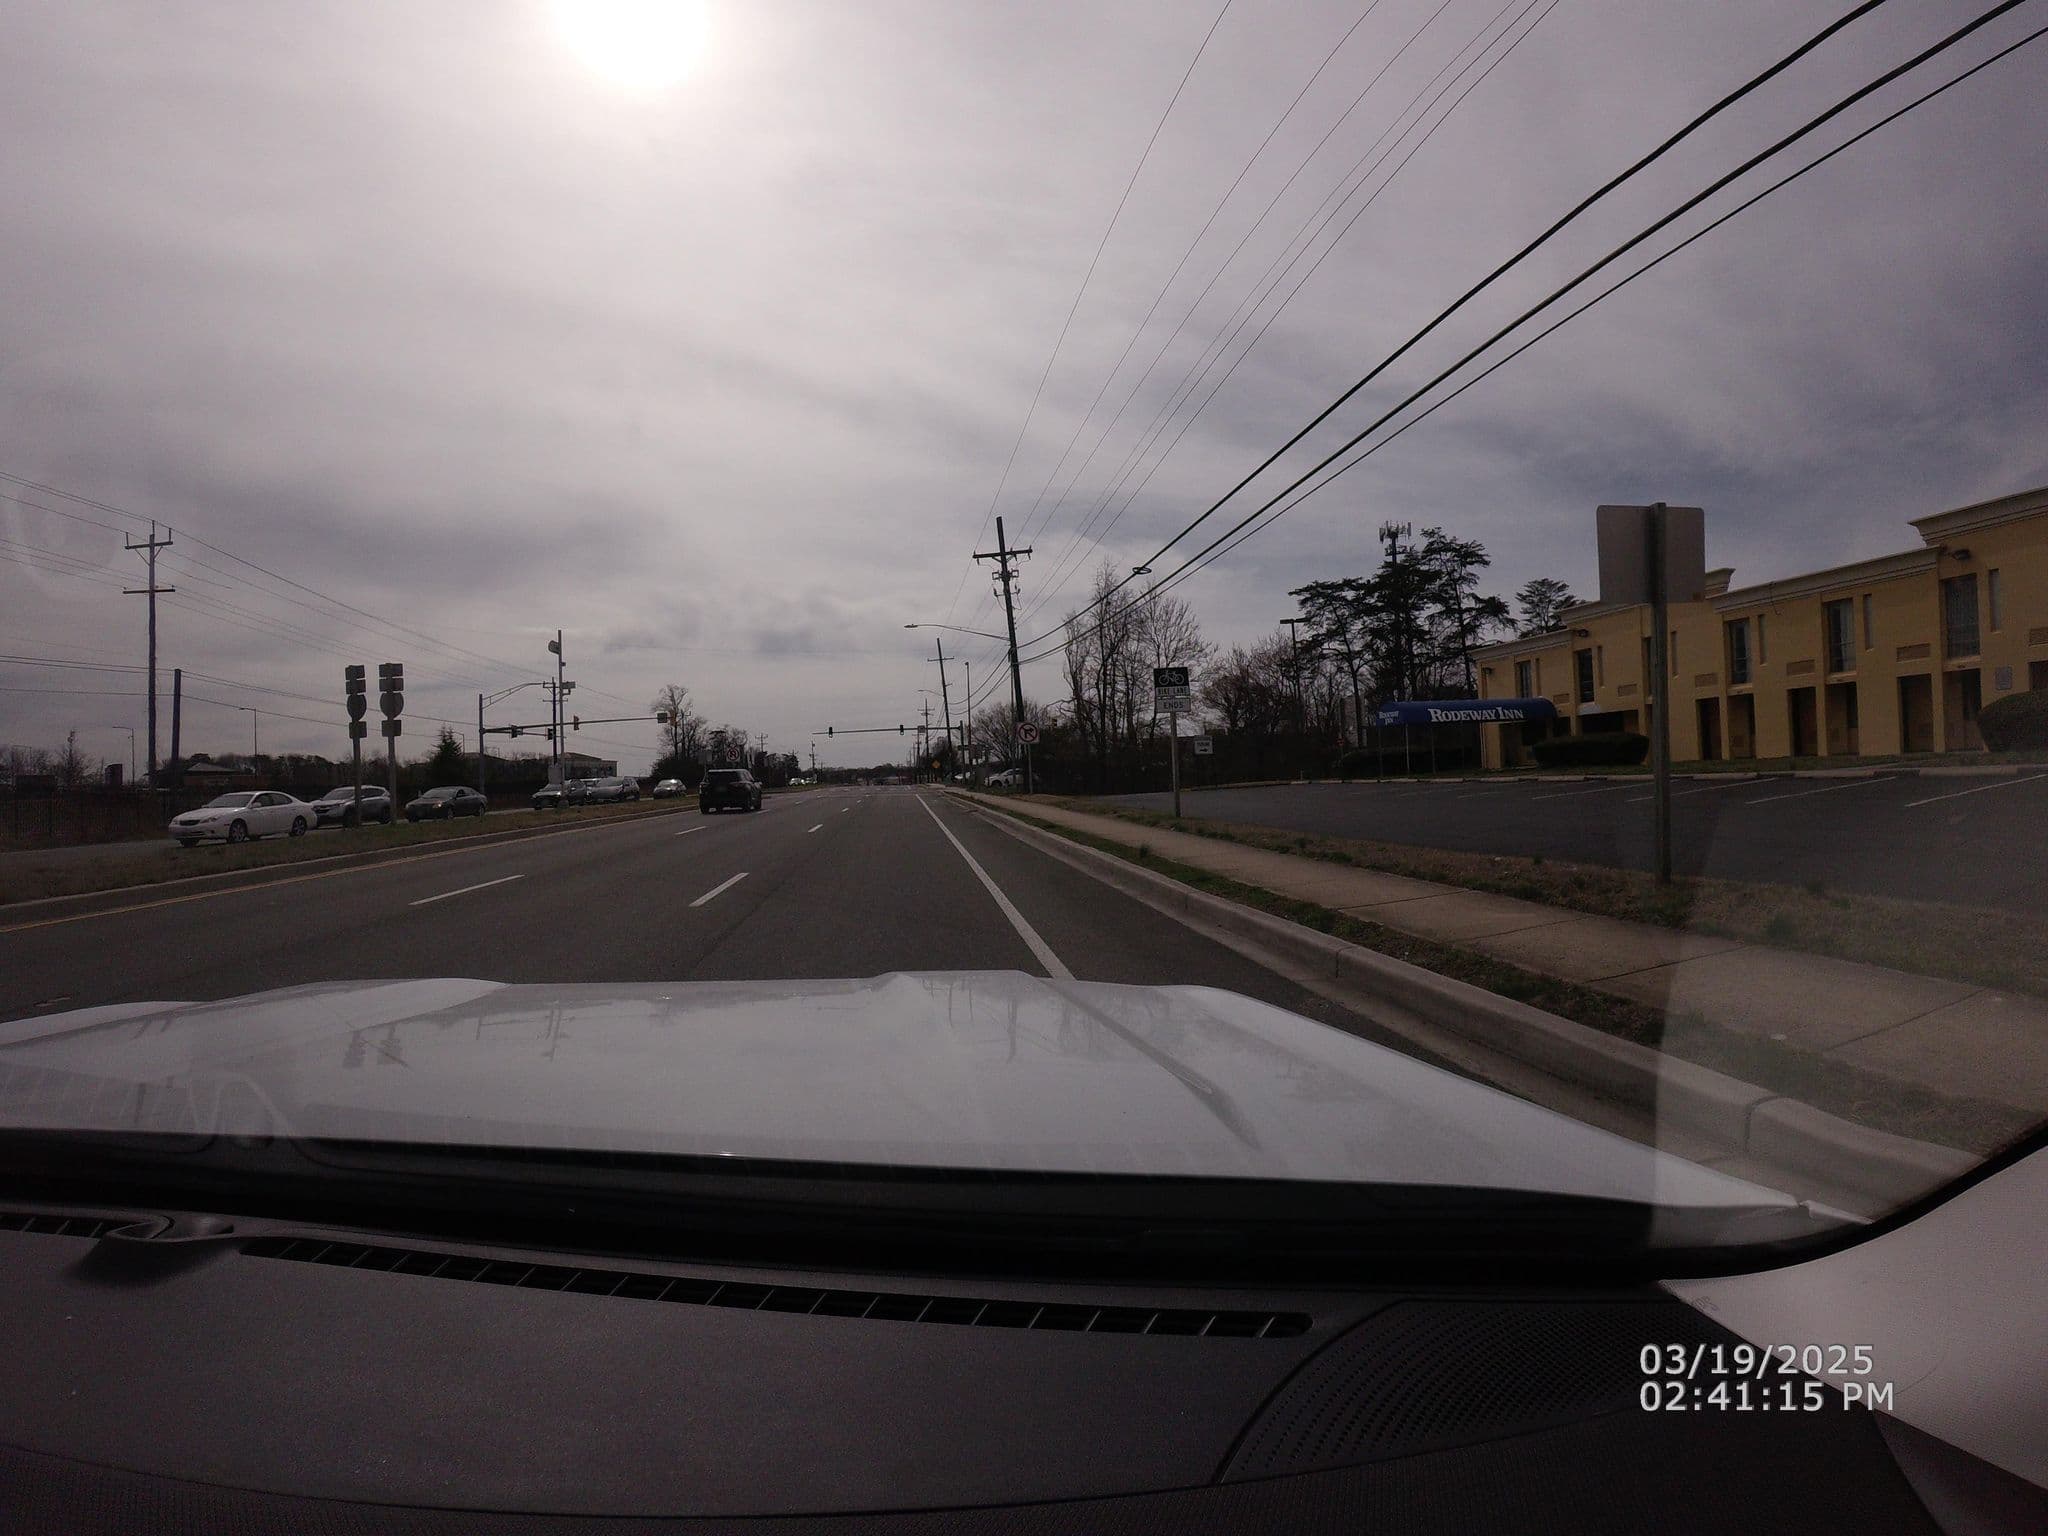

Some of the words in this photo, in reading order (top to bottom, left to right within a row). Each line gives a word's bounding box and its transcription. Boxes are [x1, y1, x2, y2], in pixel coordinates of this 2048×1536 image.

[1163, 701, 1184, 710] ENDS
[1427, 708, 1497, 722] RODEWAY
[1496, 706, 1525, 720] INN
